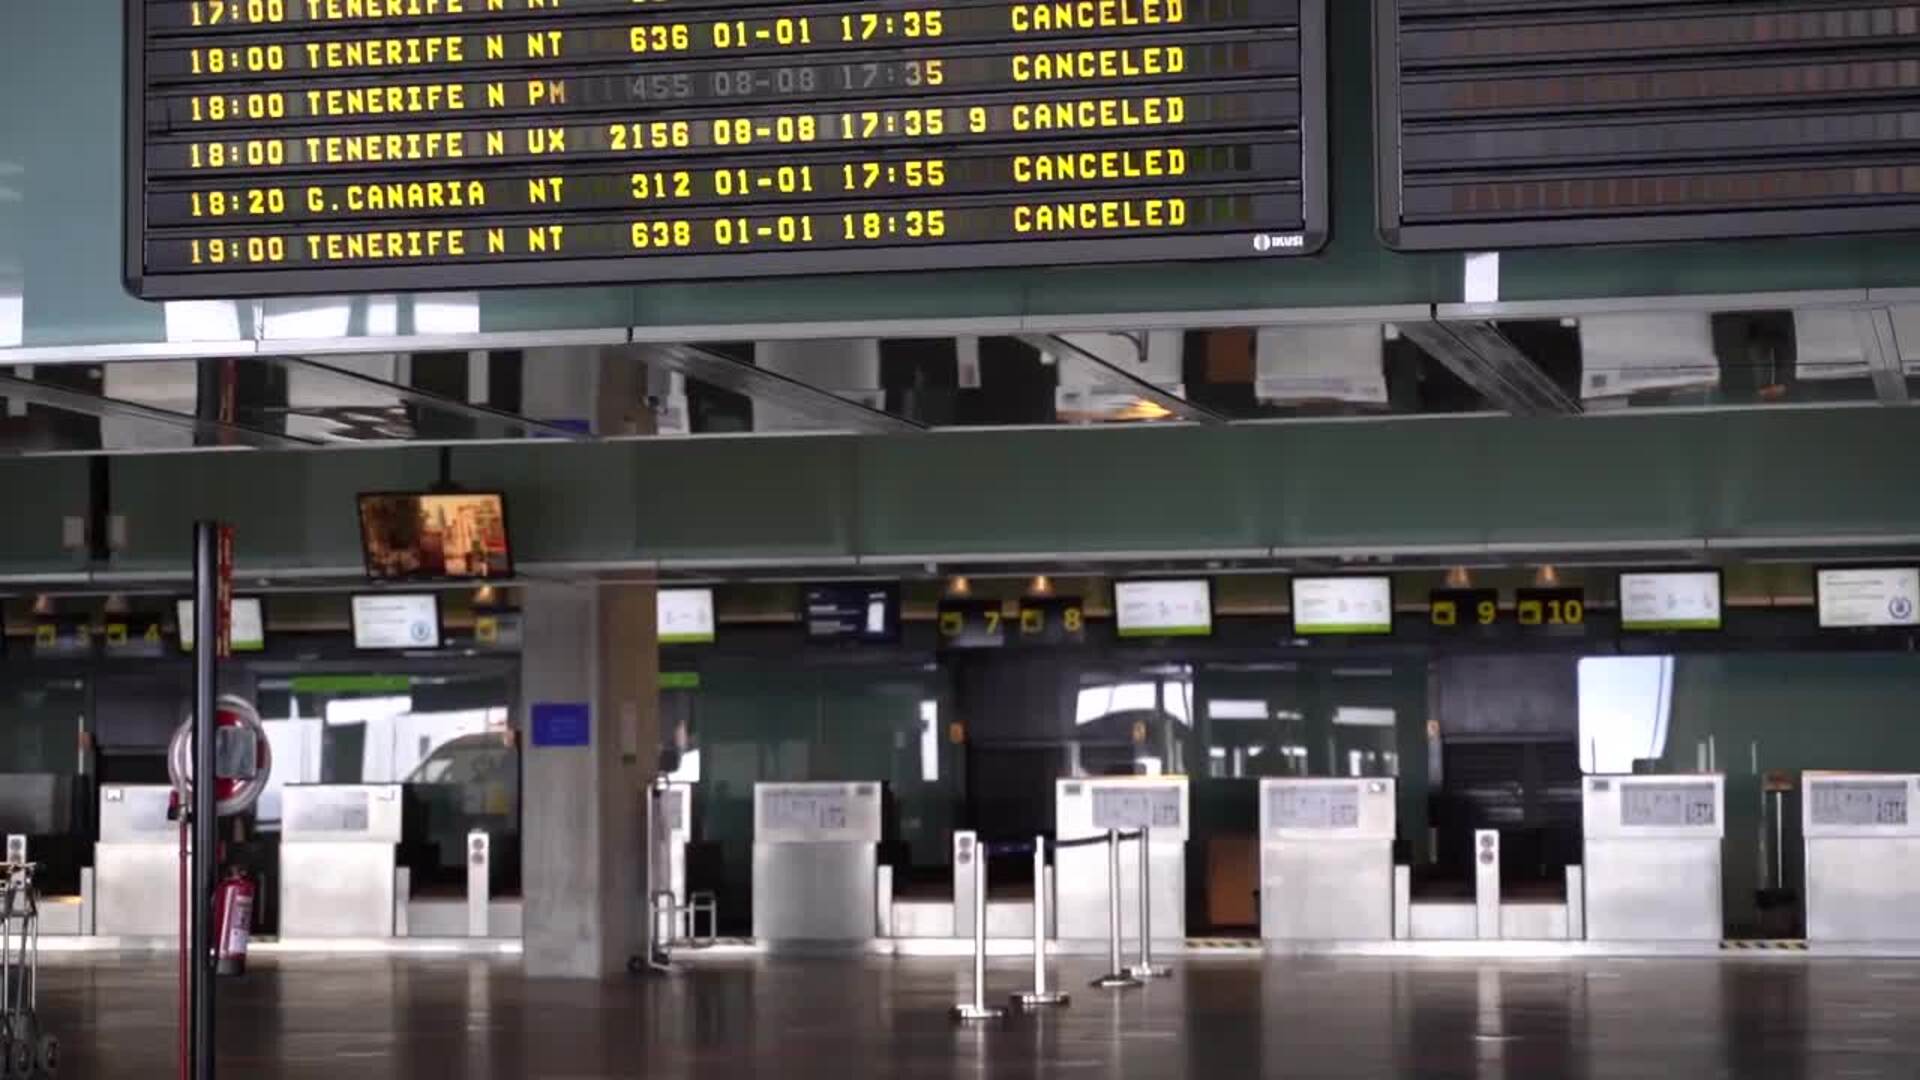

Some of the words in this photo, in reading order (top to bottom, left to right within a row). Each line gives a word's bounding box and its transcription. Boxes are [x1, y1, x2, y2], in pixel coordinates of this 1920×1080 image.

[192, 0, 284, 26] 17:00
[191, 45, 284, 74] 18:00
[307, 35, 464, 68] TENERIFE
[486, 35, 504, 59] N
[527, 30, 563, 57] NT
[629, 23, 689, 53] 636
[712, 17, 810, 49] 01-01
[841, 10, 943, 41] 17:35
[1011, 0, 1184, 32] CANCELED
[191, 92, 285, 121] 18:00
[308, 83, 465, 116] TENERIFE
[487, 84, 505, 106] N
[527, 79, 566, 104] PM
[632, 73, 690, 99] 455
[714, 67, 815, 97] 08-08
[841, 60, 943, 89] 17:35
[1012, 46, 1184, 82] CANCELED
[191, 140, 285, 168] 18:00
[307, 131, 462, 163] TENERIFE
[487, 132, 504, 153] N
[527, 129, 566, 154] UX
[610, 121, 690, 151] 2156
[713, 115, 817, 145] 08-08
[844, 108, 944, 138] 17:35
[968, 107, 987, 133] 9
[1012, 96, 1185, 132] CANCELED
[191, 188, 285, 217] 18:20
[307, 180, 485, 213] G.CANARIA
[528, 176, 564, 202] NT
[631, 171, 691, 199] 312
[714, 166, 813, 196] 01-01
[843, 159, 945, 190] 17:55
[1013, 148, 1186, 183] CANCELED
[191, 236, 285, 263] 19:00
[308, 229, 464, 260] TENERIFE
[487, 230, 505, 252] N
[528, 225, 564, 250] NT
[631, 220, 691, 248] 638
[714, 215, 813, 245] 01-01
[843, 209, 945, 240] 18:35
[1013, 198, 1186, 233] CANCELED
[984, 611, 1000, 635] 7
[1063, 607, 1081, 632] 8
[1476, 600, 1496, 625] 9
[1547, 599, 1583, 625] 10
